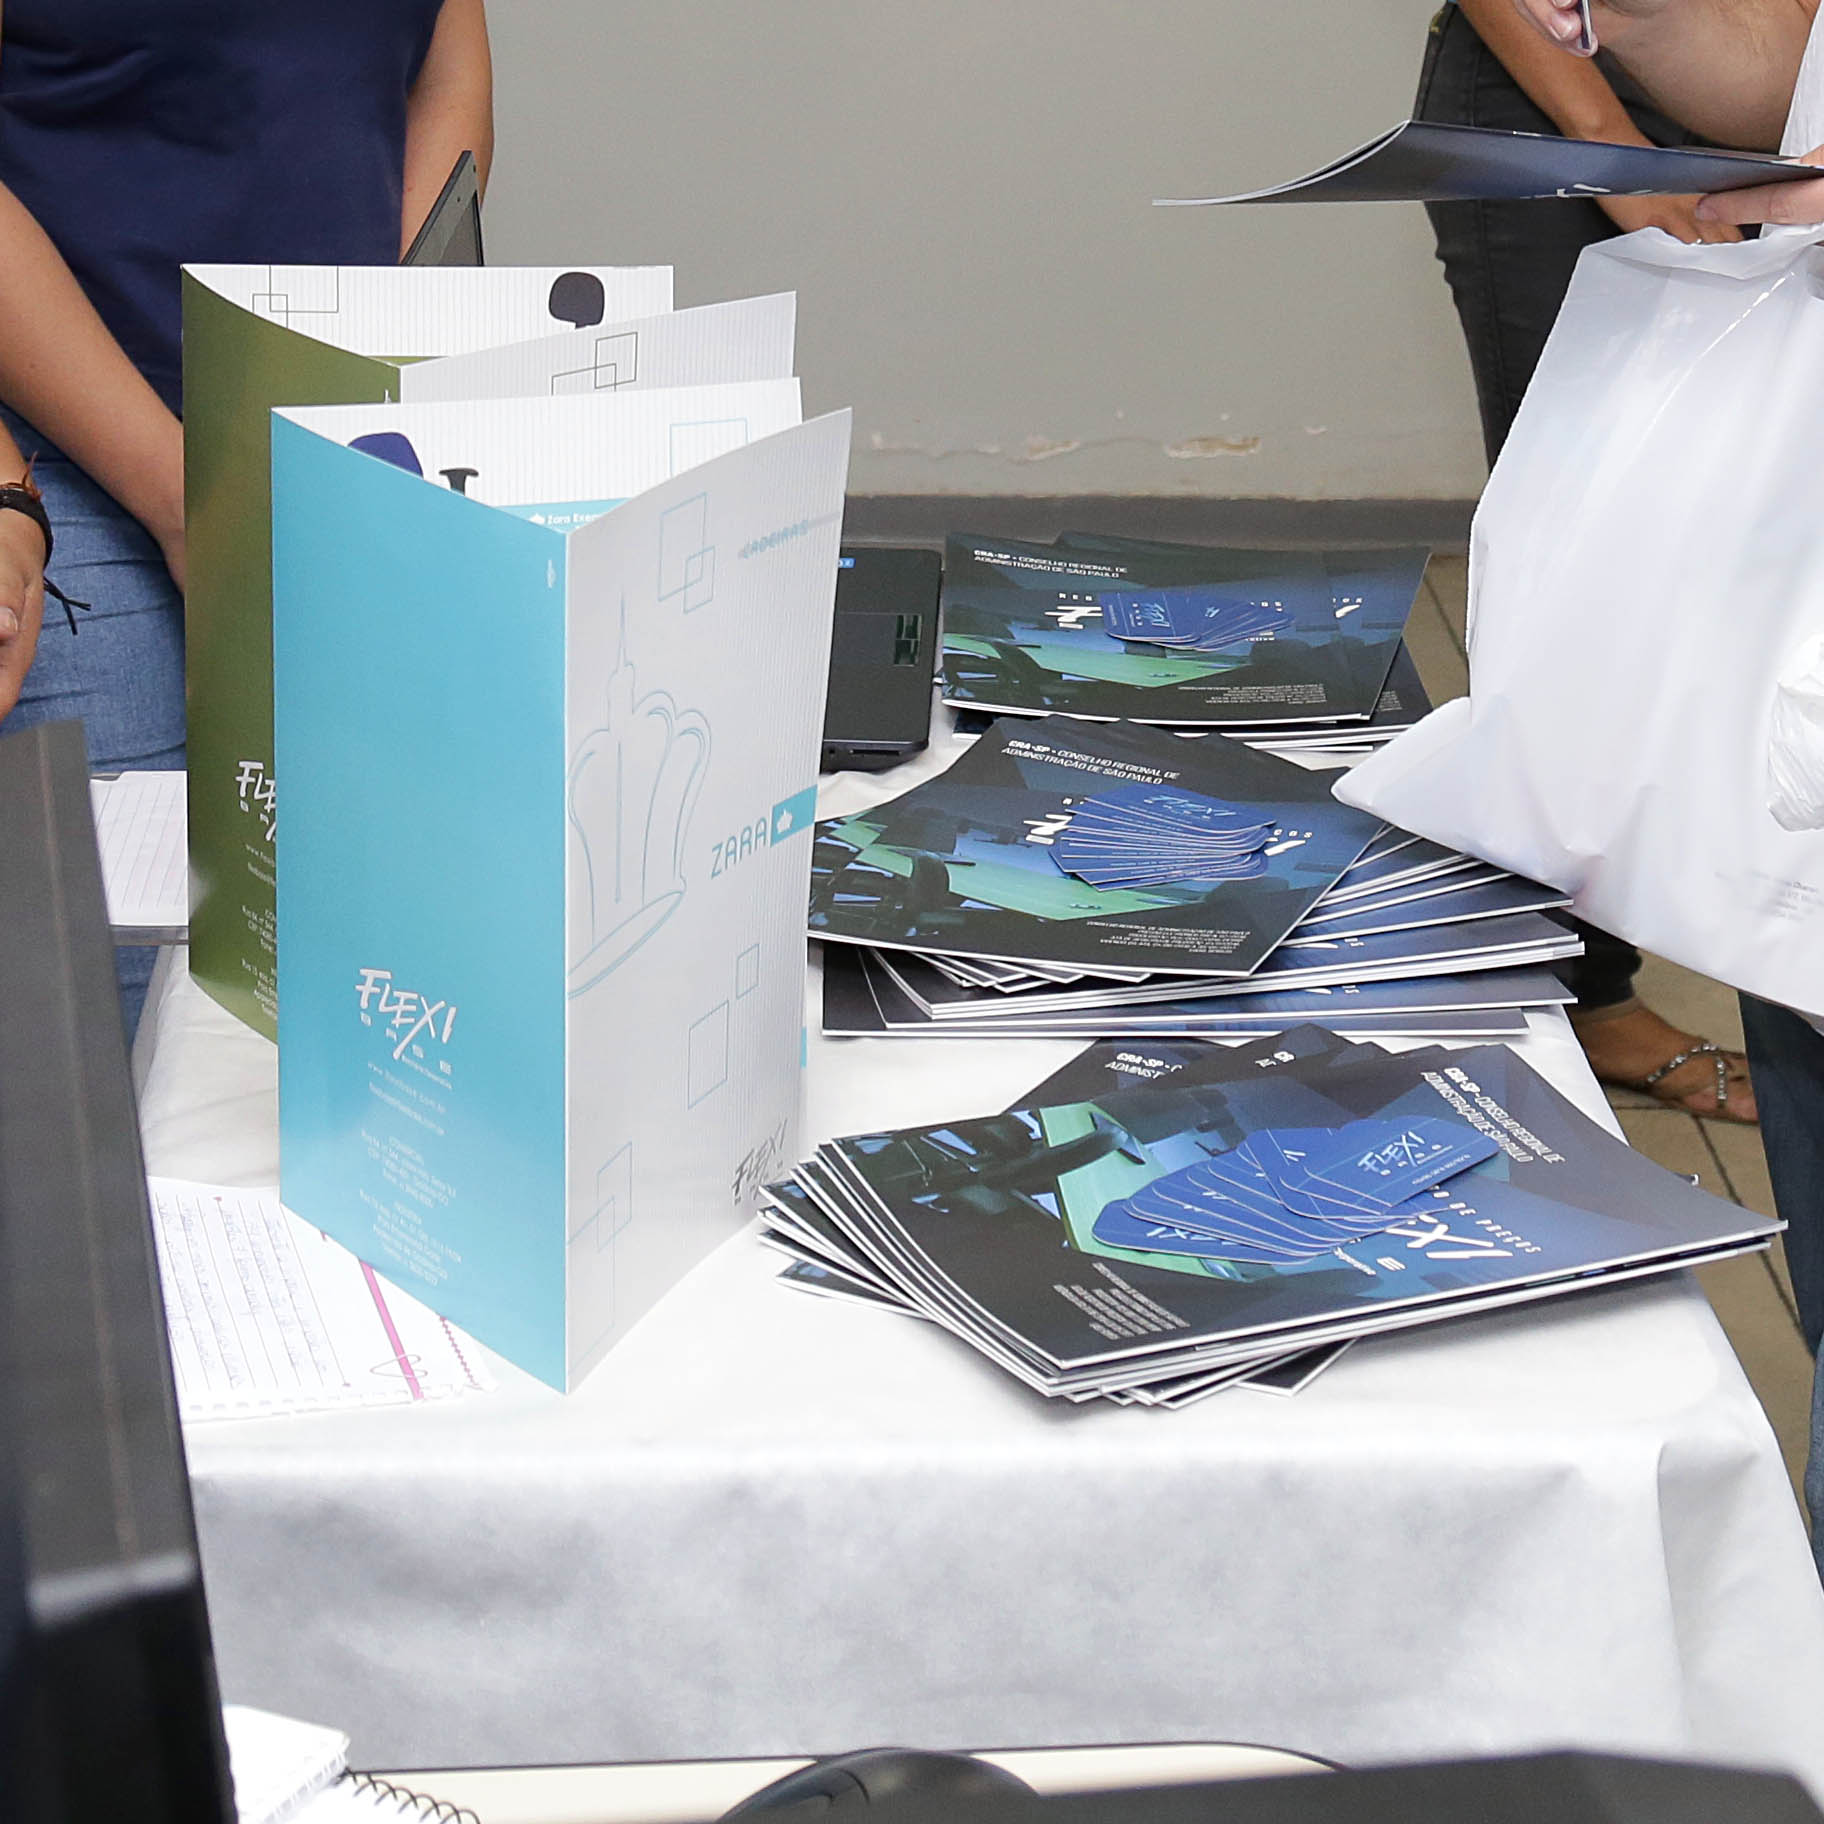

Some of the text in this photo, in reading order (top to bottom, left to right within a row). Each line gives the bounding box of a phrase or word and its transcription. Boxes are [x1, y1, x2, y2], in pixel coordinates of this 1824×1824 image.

[1019, 555, 1067, 568] CONSELHO
[1068, 561, 1112, 573] REGIONAL
[1115, 566, 1128, 574] DE
[1051, 566, 1065, 574] DE
[1087, 570, 1120, 579] PAULO
[1008, 739, 1181, 780] CRA-SP CONSELHO REGIONAL DE
[1086, 762, 1104, 773] DE
[1126, 772, 1164, 786] PAULO
[234, 760, 276, 842] FLE
[711, 817, 768, 880] ZARA
[355, 967, 457, 1061] FLEXI
[1357, 1130, 1426, 1174] FLEXI
